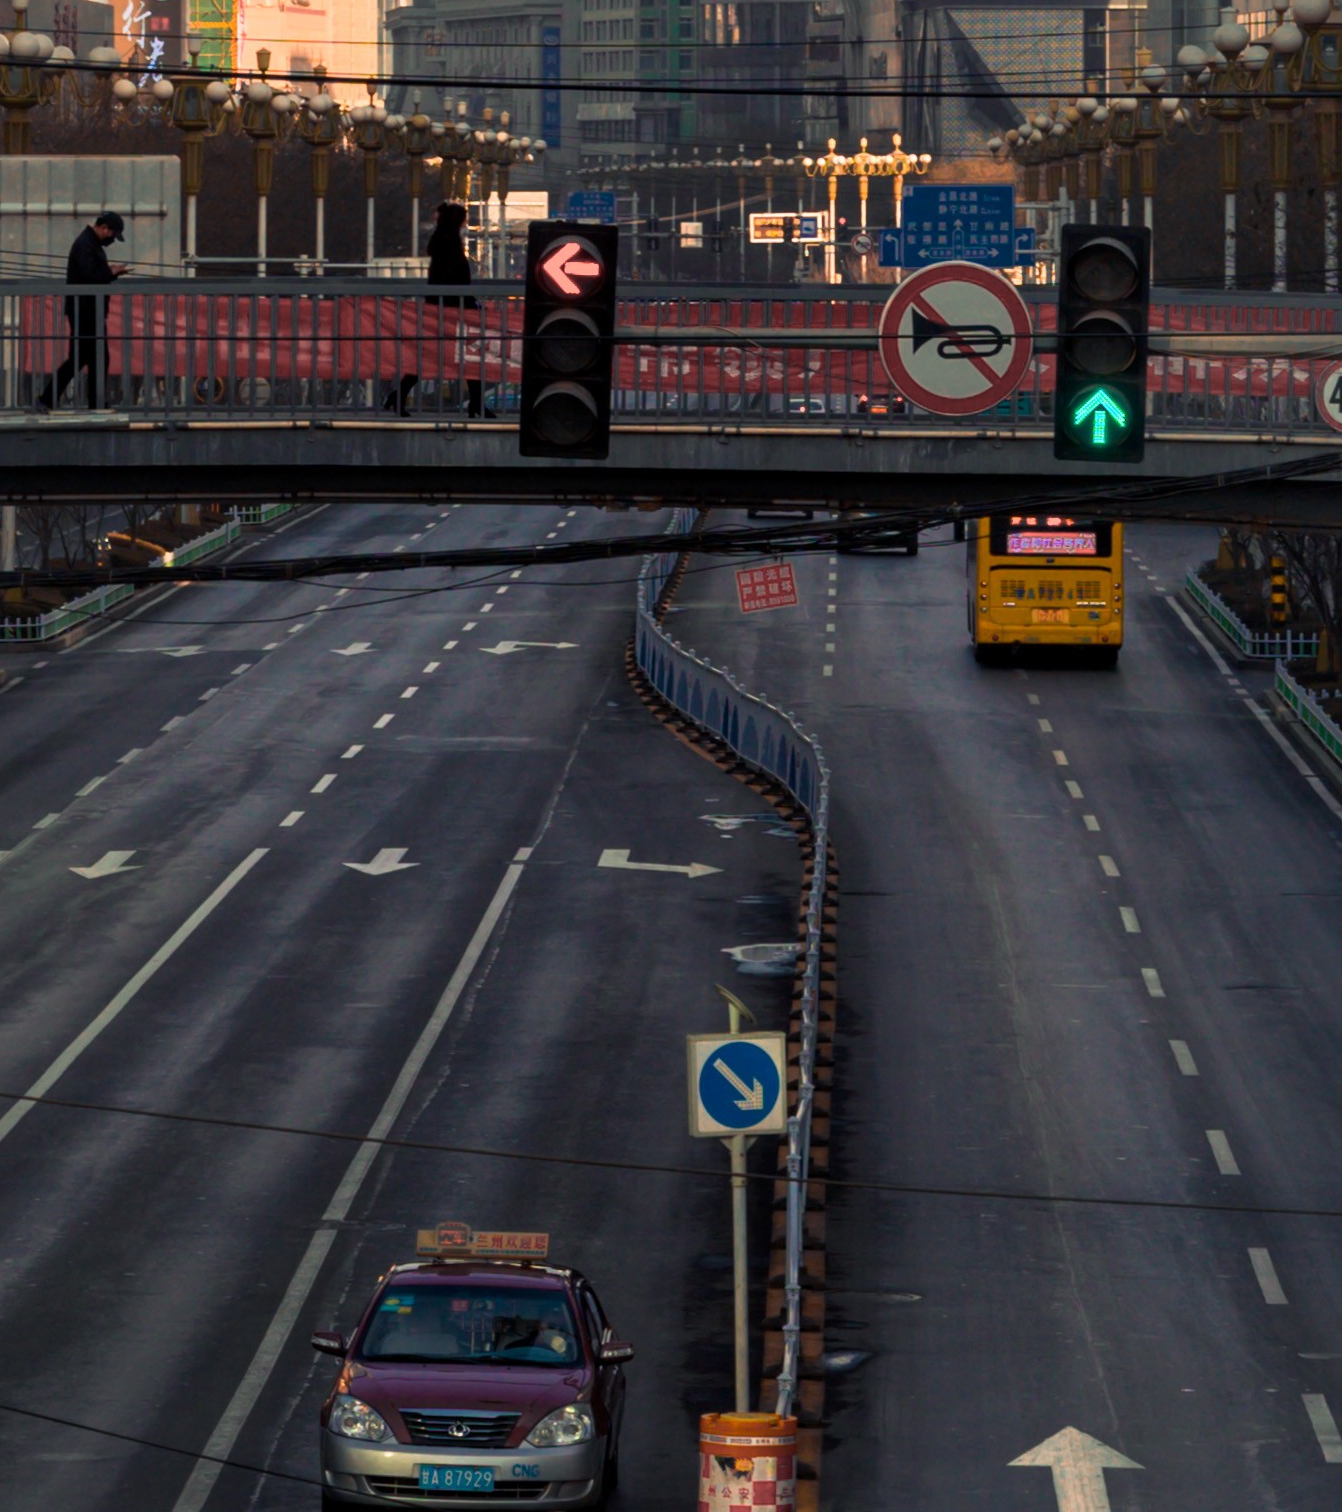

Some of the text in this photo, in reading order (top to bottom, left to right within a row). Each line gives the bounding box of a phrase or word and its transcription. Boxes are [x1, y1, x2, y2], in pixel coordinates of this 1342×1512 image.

[476, 1234, 547, 1249] 兰州欢迎您
[512, 1464, 540, 1478] CNG
